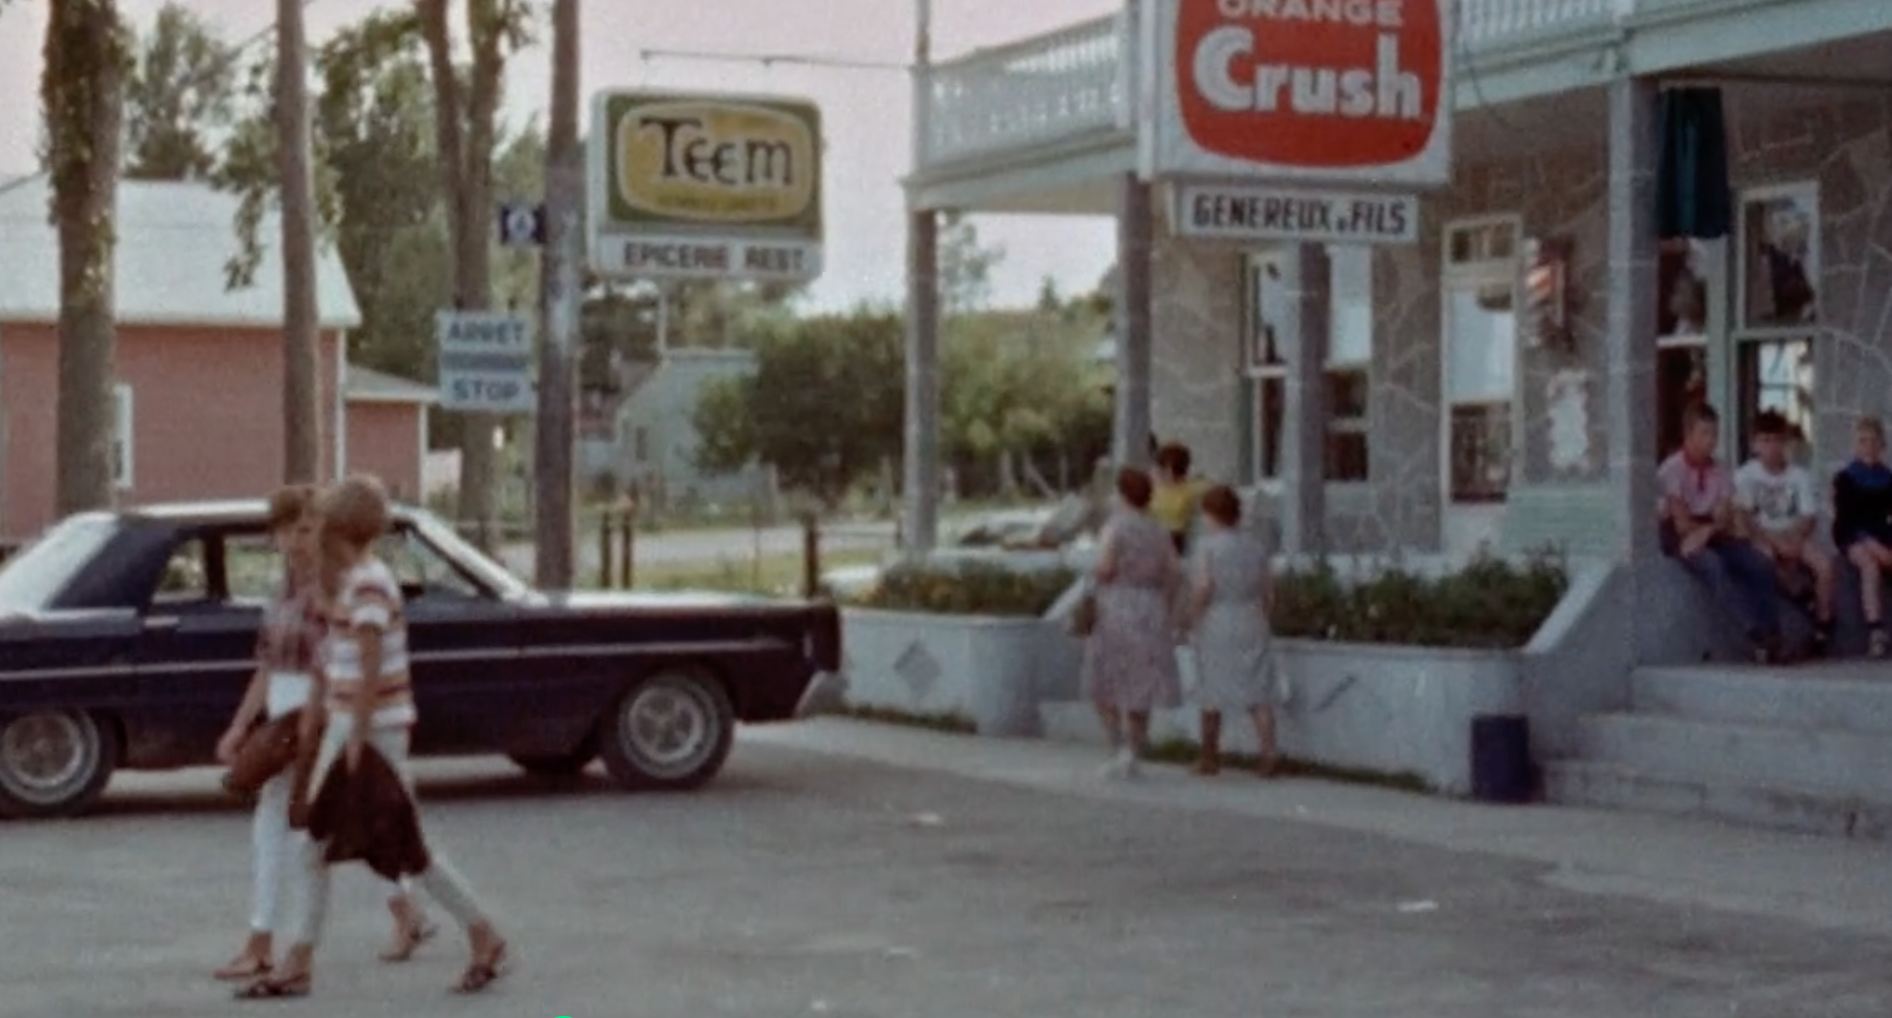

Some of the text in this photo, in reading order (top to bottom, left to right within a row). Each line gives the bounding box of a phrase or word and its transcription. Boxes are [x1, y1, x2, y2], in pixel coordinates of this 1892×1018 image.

[1217, 0, 1404, 27] ORANGE
[1193, 26, 1422, 119] Crush
[1193, 193, 1332, 232] GENEREUX
[1350, 200, 1406, 235] FILS
[453, 377, 520, 401] STOP
